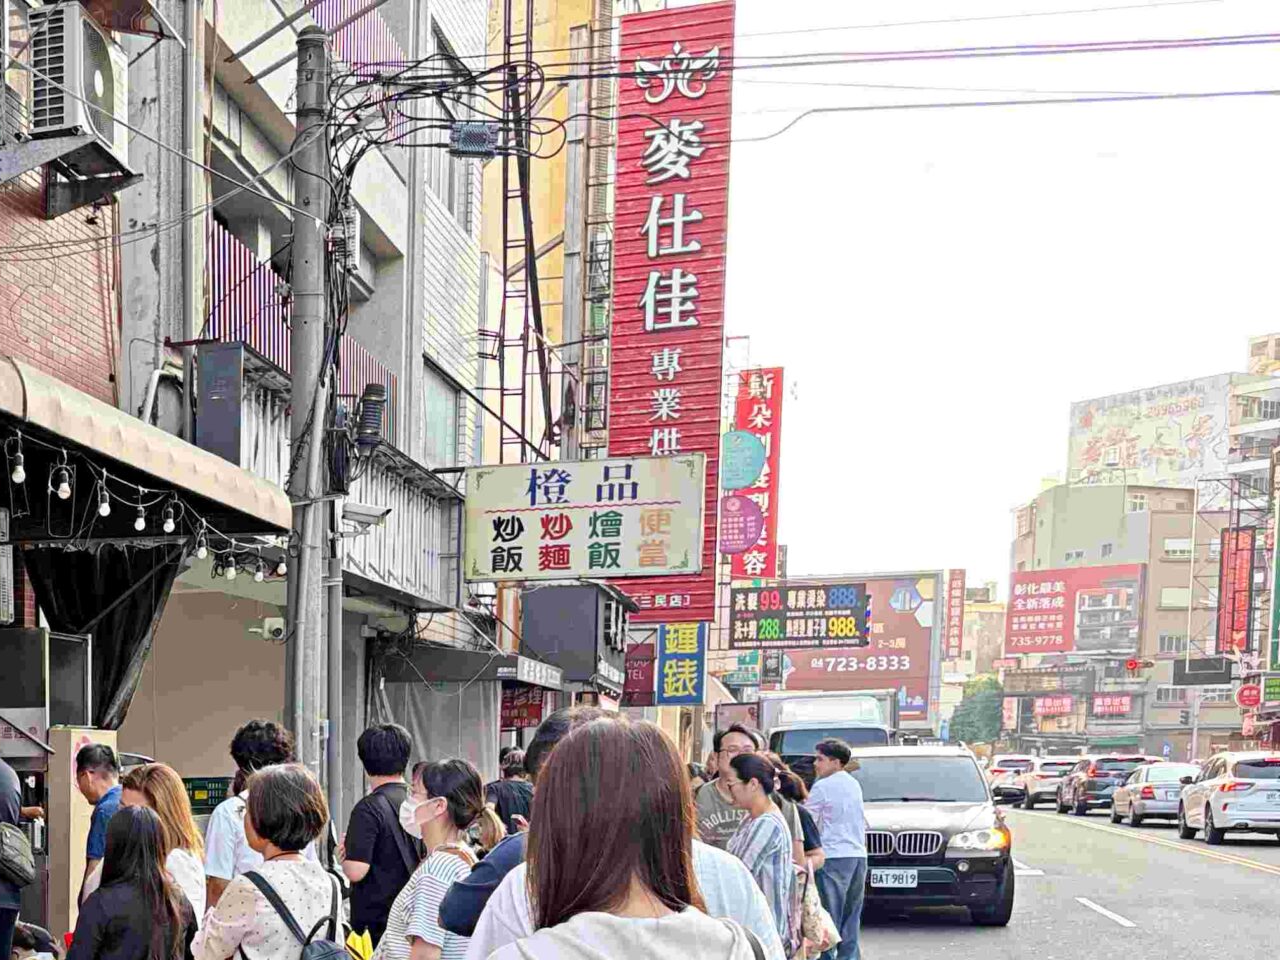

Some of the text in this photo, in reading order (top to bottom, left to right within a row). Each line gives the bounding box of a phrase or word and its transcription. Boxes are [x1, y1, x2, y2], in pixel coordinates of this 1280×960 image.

[640, 119, 704, 332] 麥仕佳
[526, 464, 639, 506] 橙品
[491, 516, 524, 573] 炒飯
[538, 513, 572, 571] 炒麵
[587, 511, 623, 568] 燴飯
[637, 508, 670, 567] 便當
[825, 655, 910, 672] 723-8333
[1011, 636, 1063, 647] 735-9778
